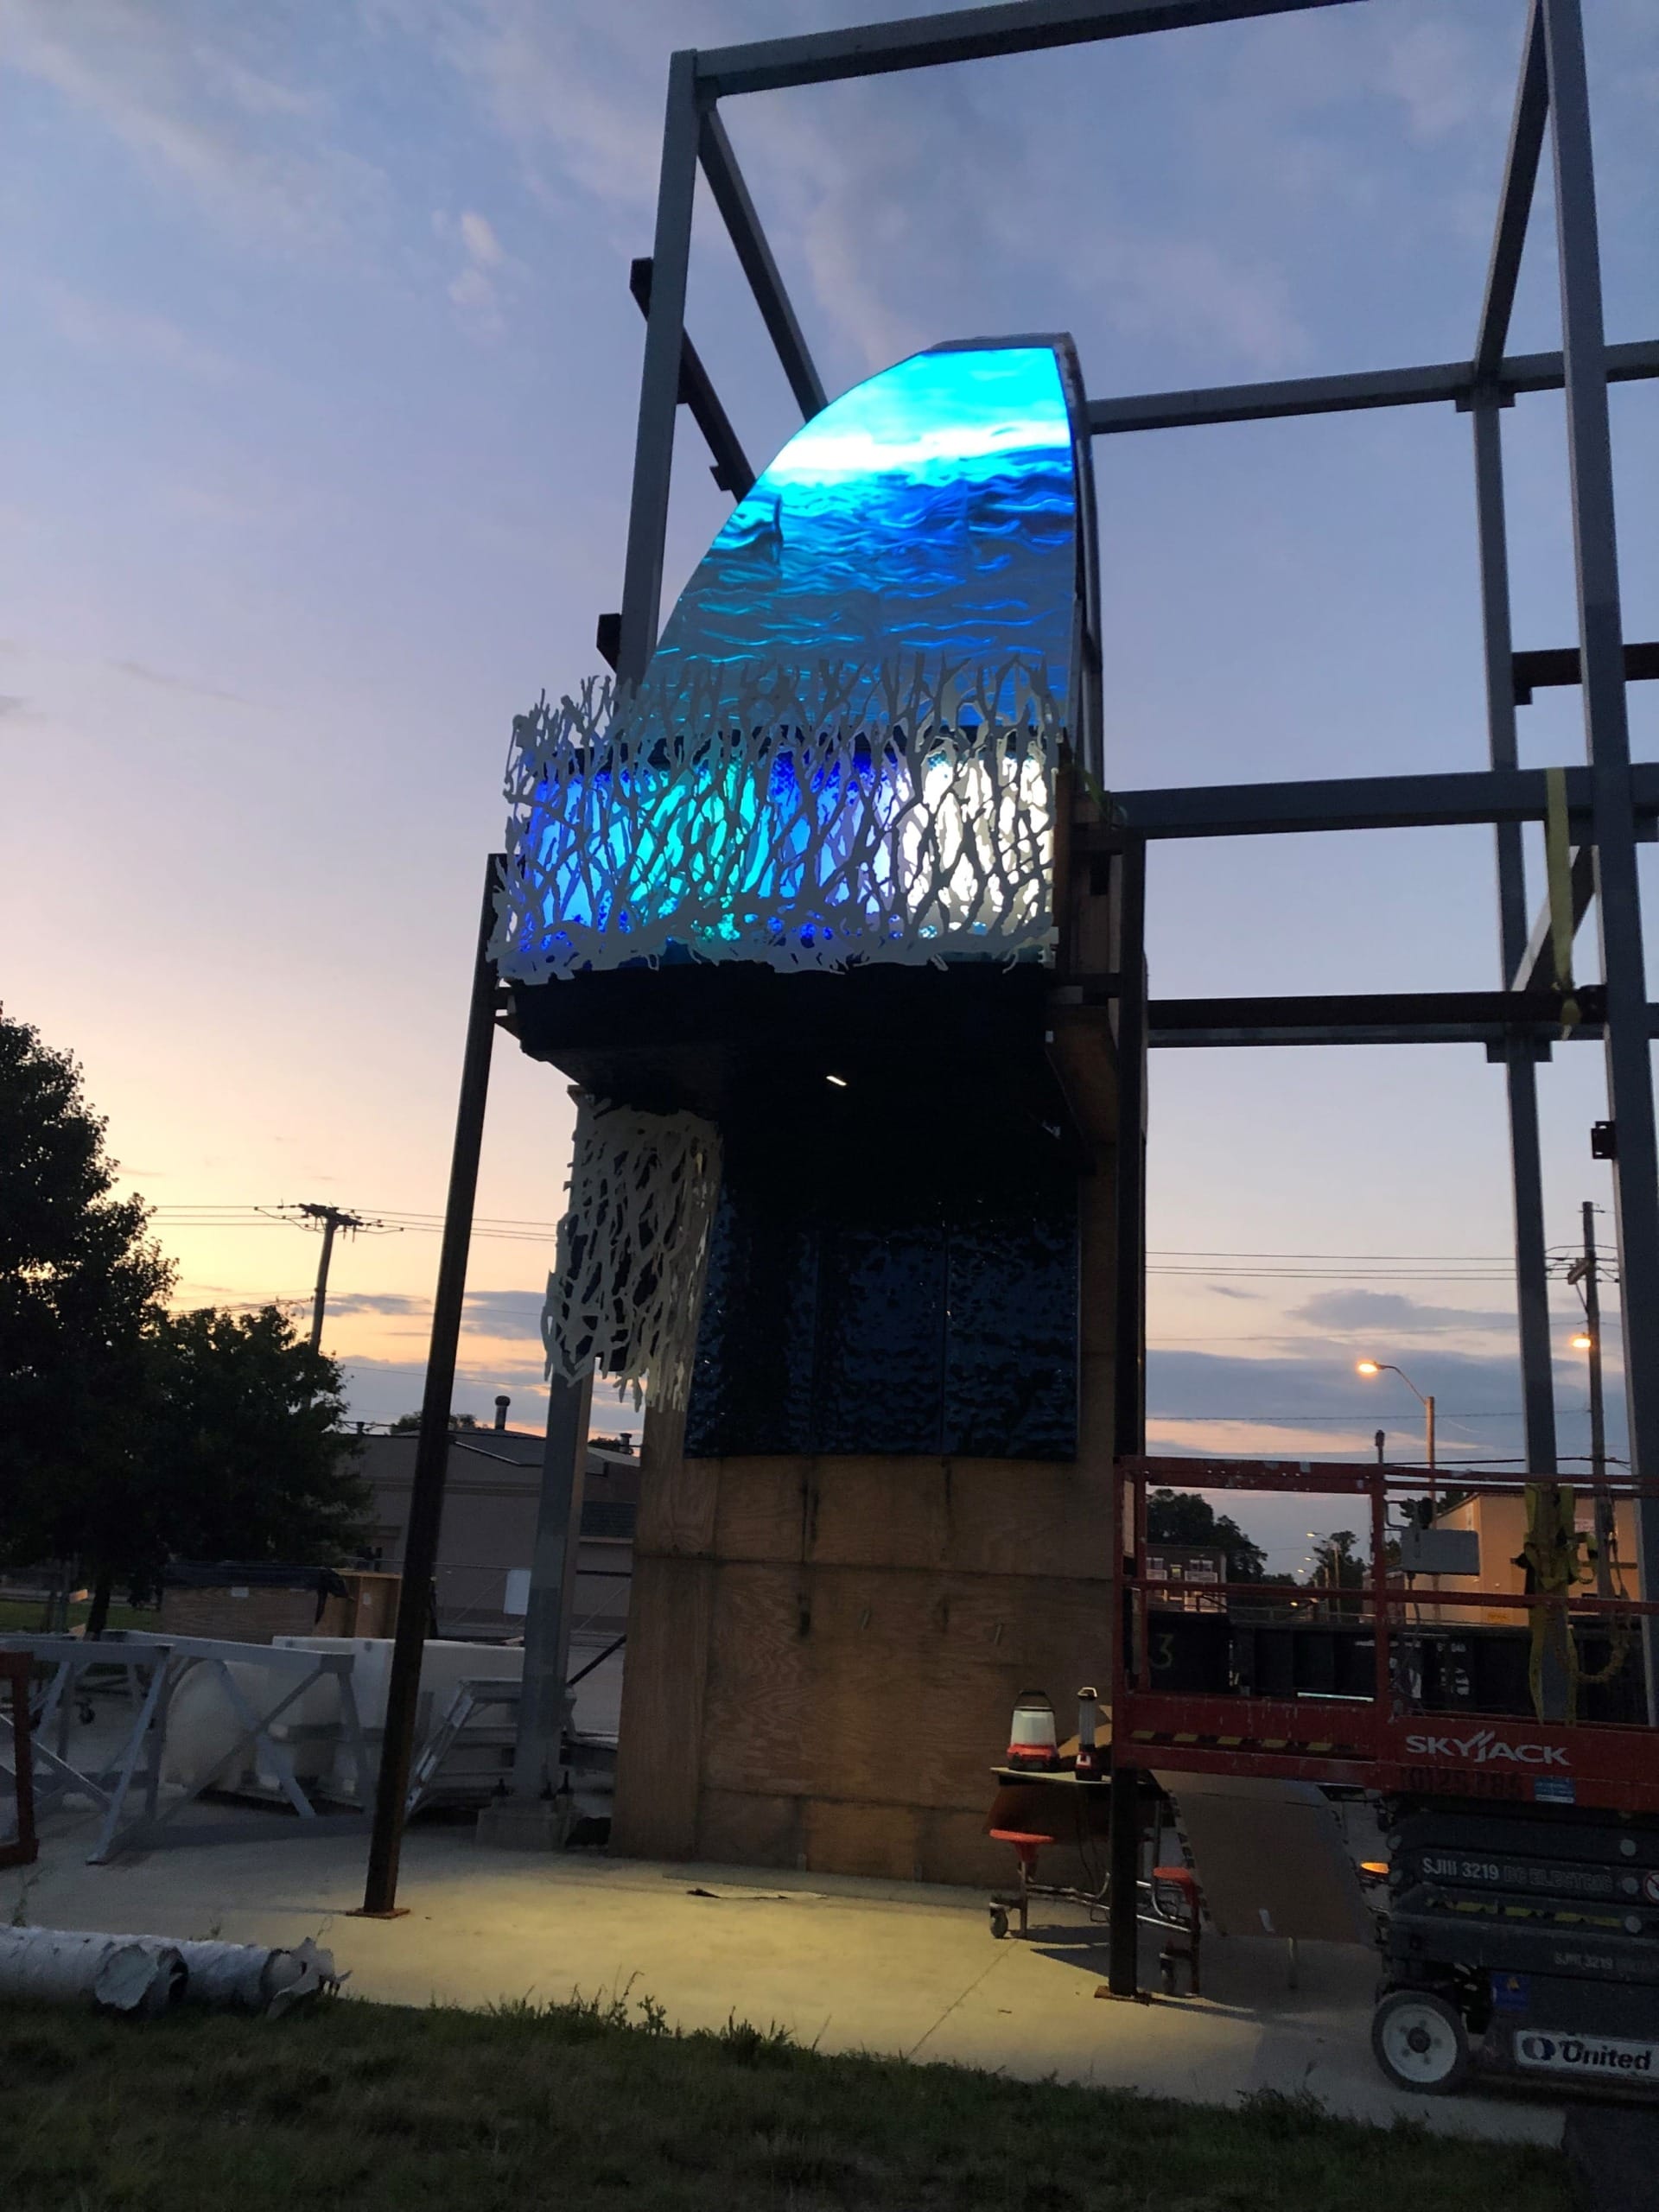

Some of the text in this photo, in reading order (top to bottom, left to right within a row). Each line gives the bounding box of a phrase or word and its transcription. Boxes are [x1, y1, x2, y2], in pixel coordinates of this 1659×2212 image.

[1150, 1633, 1174, 1670] 3
[1405, 1729, 1573, 1766] SKYJACK
[1462, 1861, 1499, 1881] 3219
[1559, 2039, 1651, 2070] United
